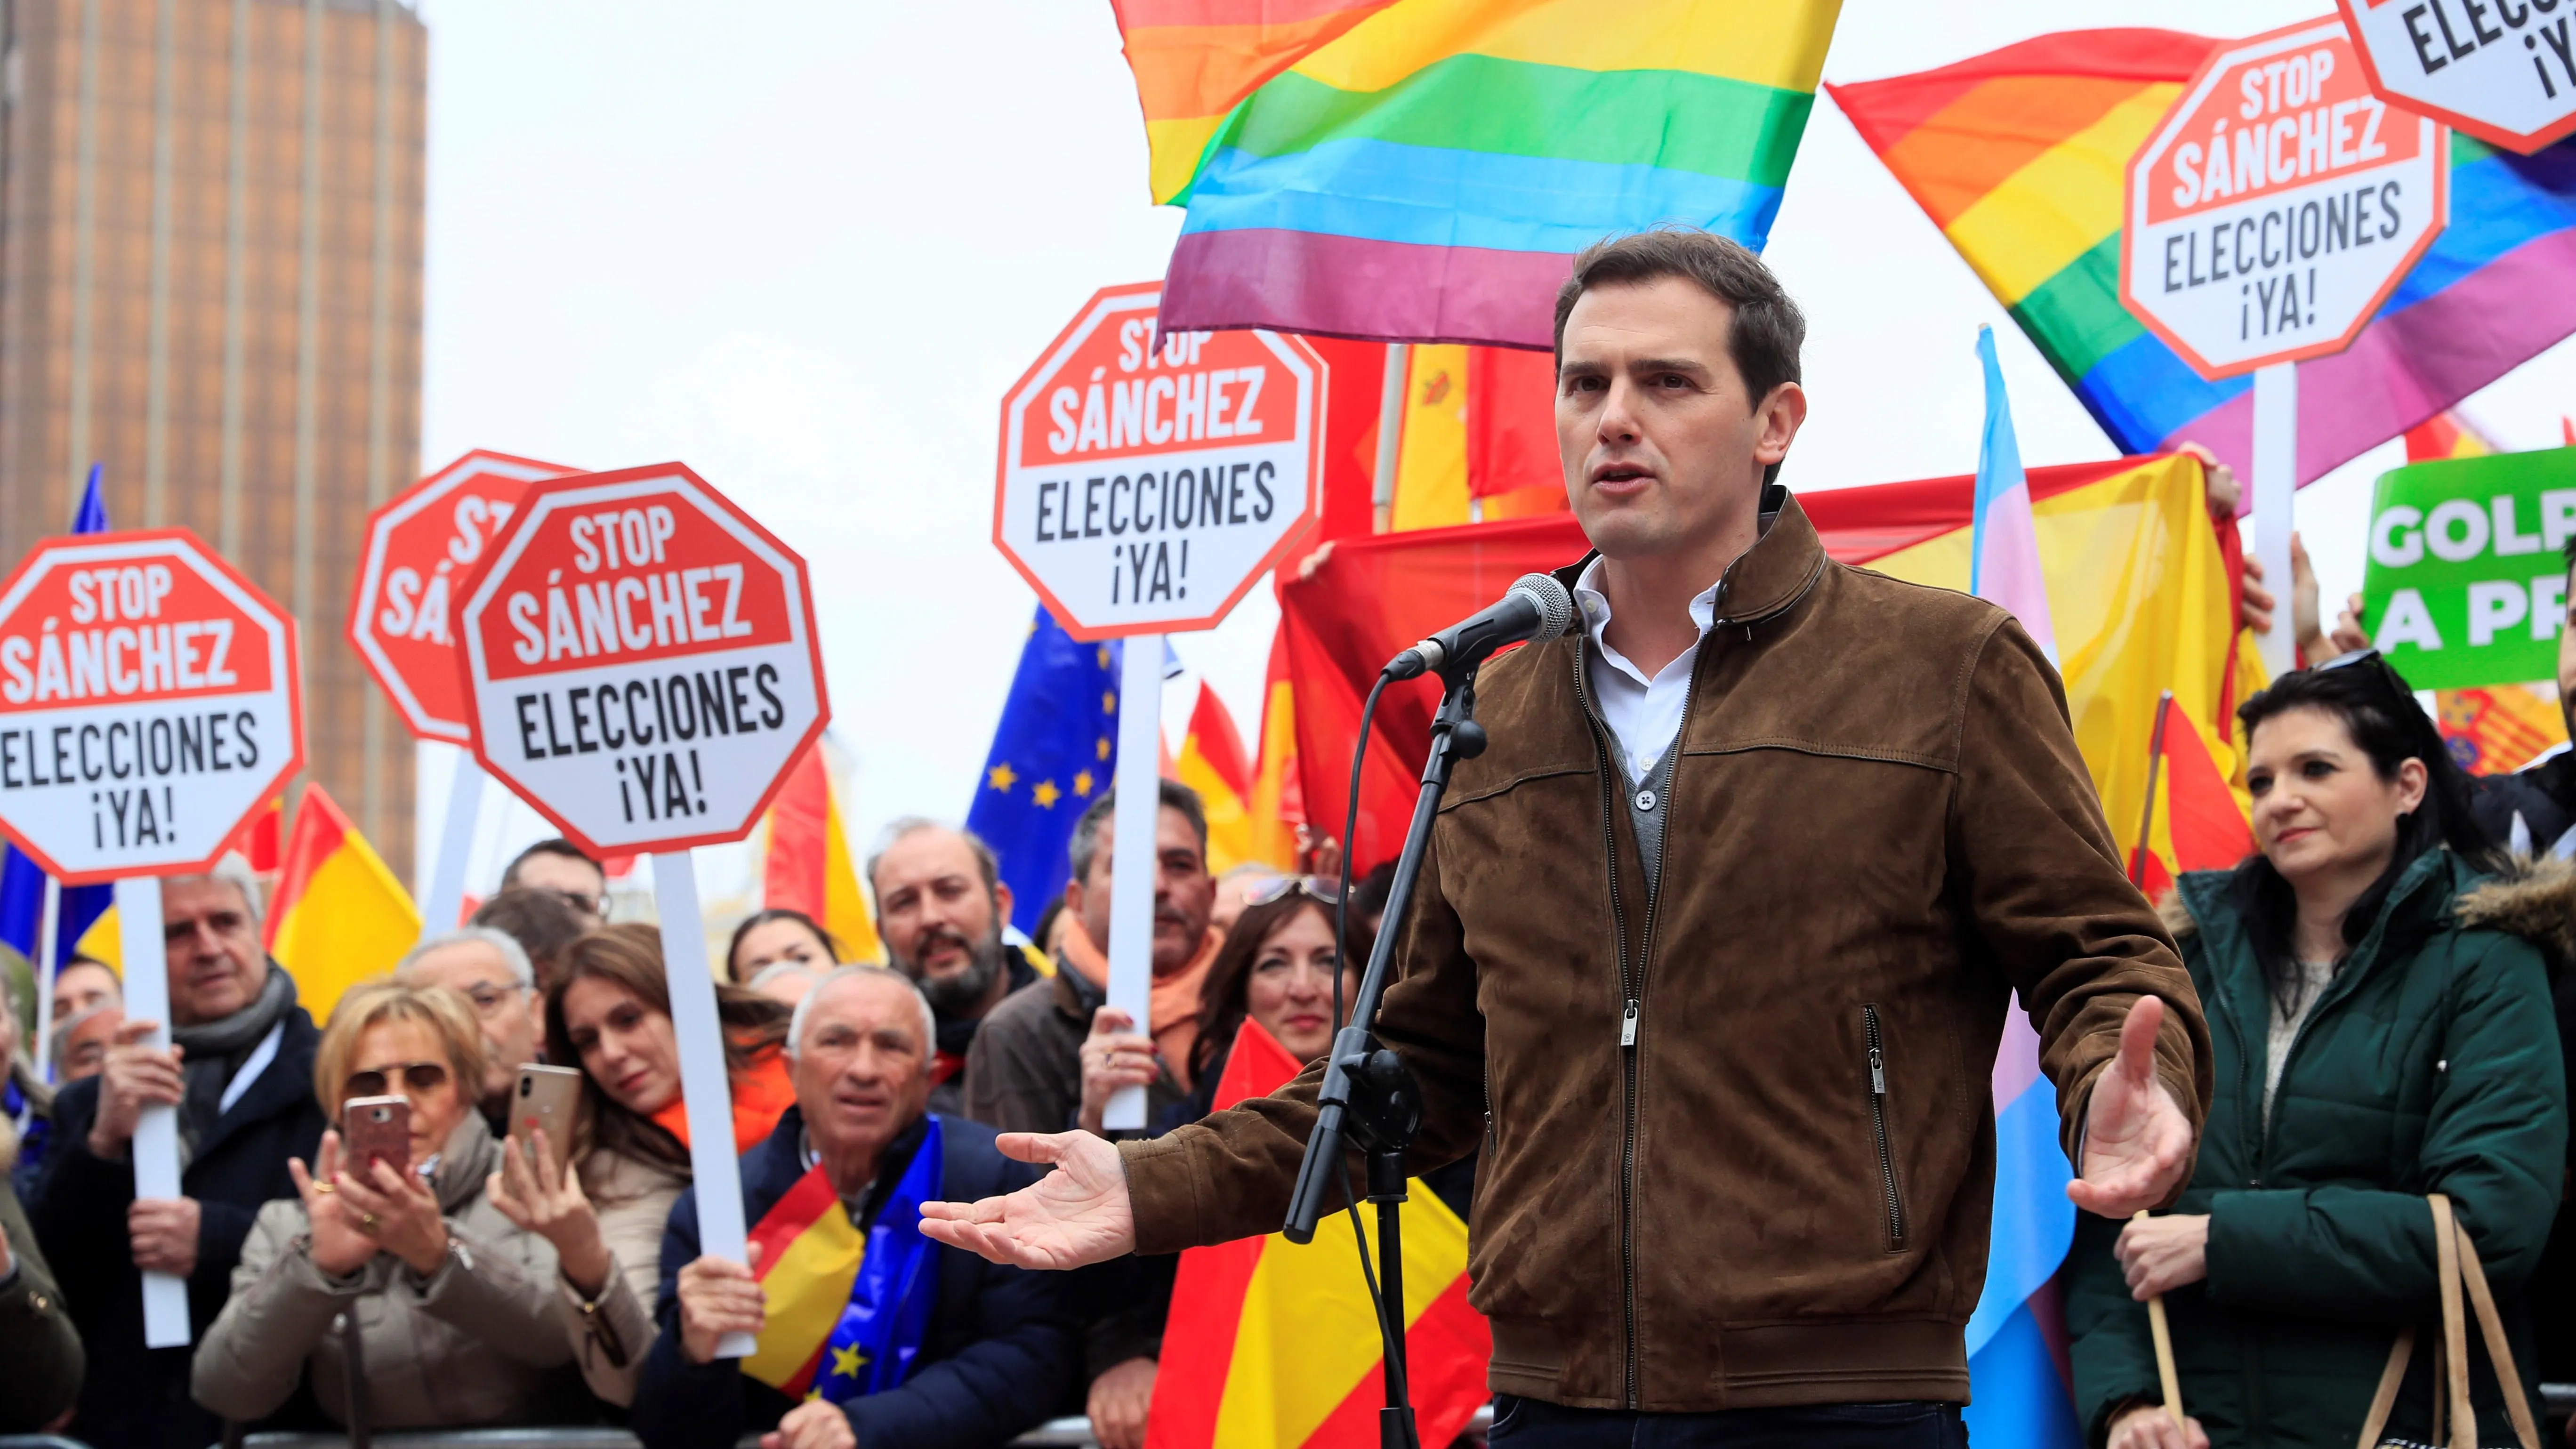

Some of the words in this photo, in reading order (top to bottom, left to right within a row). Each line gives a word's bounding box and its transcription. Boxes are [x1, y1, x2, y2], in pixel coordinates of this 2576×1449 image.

[2239, 48, 2335, 120] STOP
[2524, 10, 2576, 99] ¡Y
[2172, 95, 2387, 209] SÁNCHEZ
[2165, 180, 2402, 293] ELECCIONES
[2242, 267, 2315, 341] ¡YA!
[1048, 365, 1266, 455] SÁNCHEZ
[570, 505, 675, 573] STOP
[1037, 460, 1275, 543] ELECCIONES
[69, 564, 173, 624] STOP
[1112, 539, 1188, 604] ¡YA!
[507, 562, 753, 665] SÁNCHEZ
[2372, 588, 2444, 655] A
[0, 617, 237, 704] SÁNCHEZ
[1, 711, 258, 789] ELECCIONES
[516, 663, 784, 759] ELECCIONES
[92, 786, 176, 849] ¡YA!
[616, 749, 707, 822] ¡YA!
